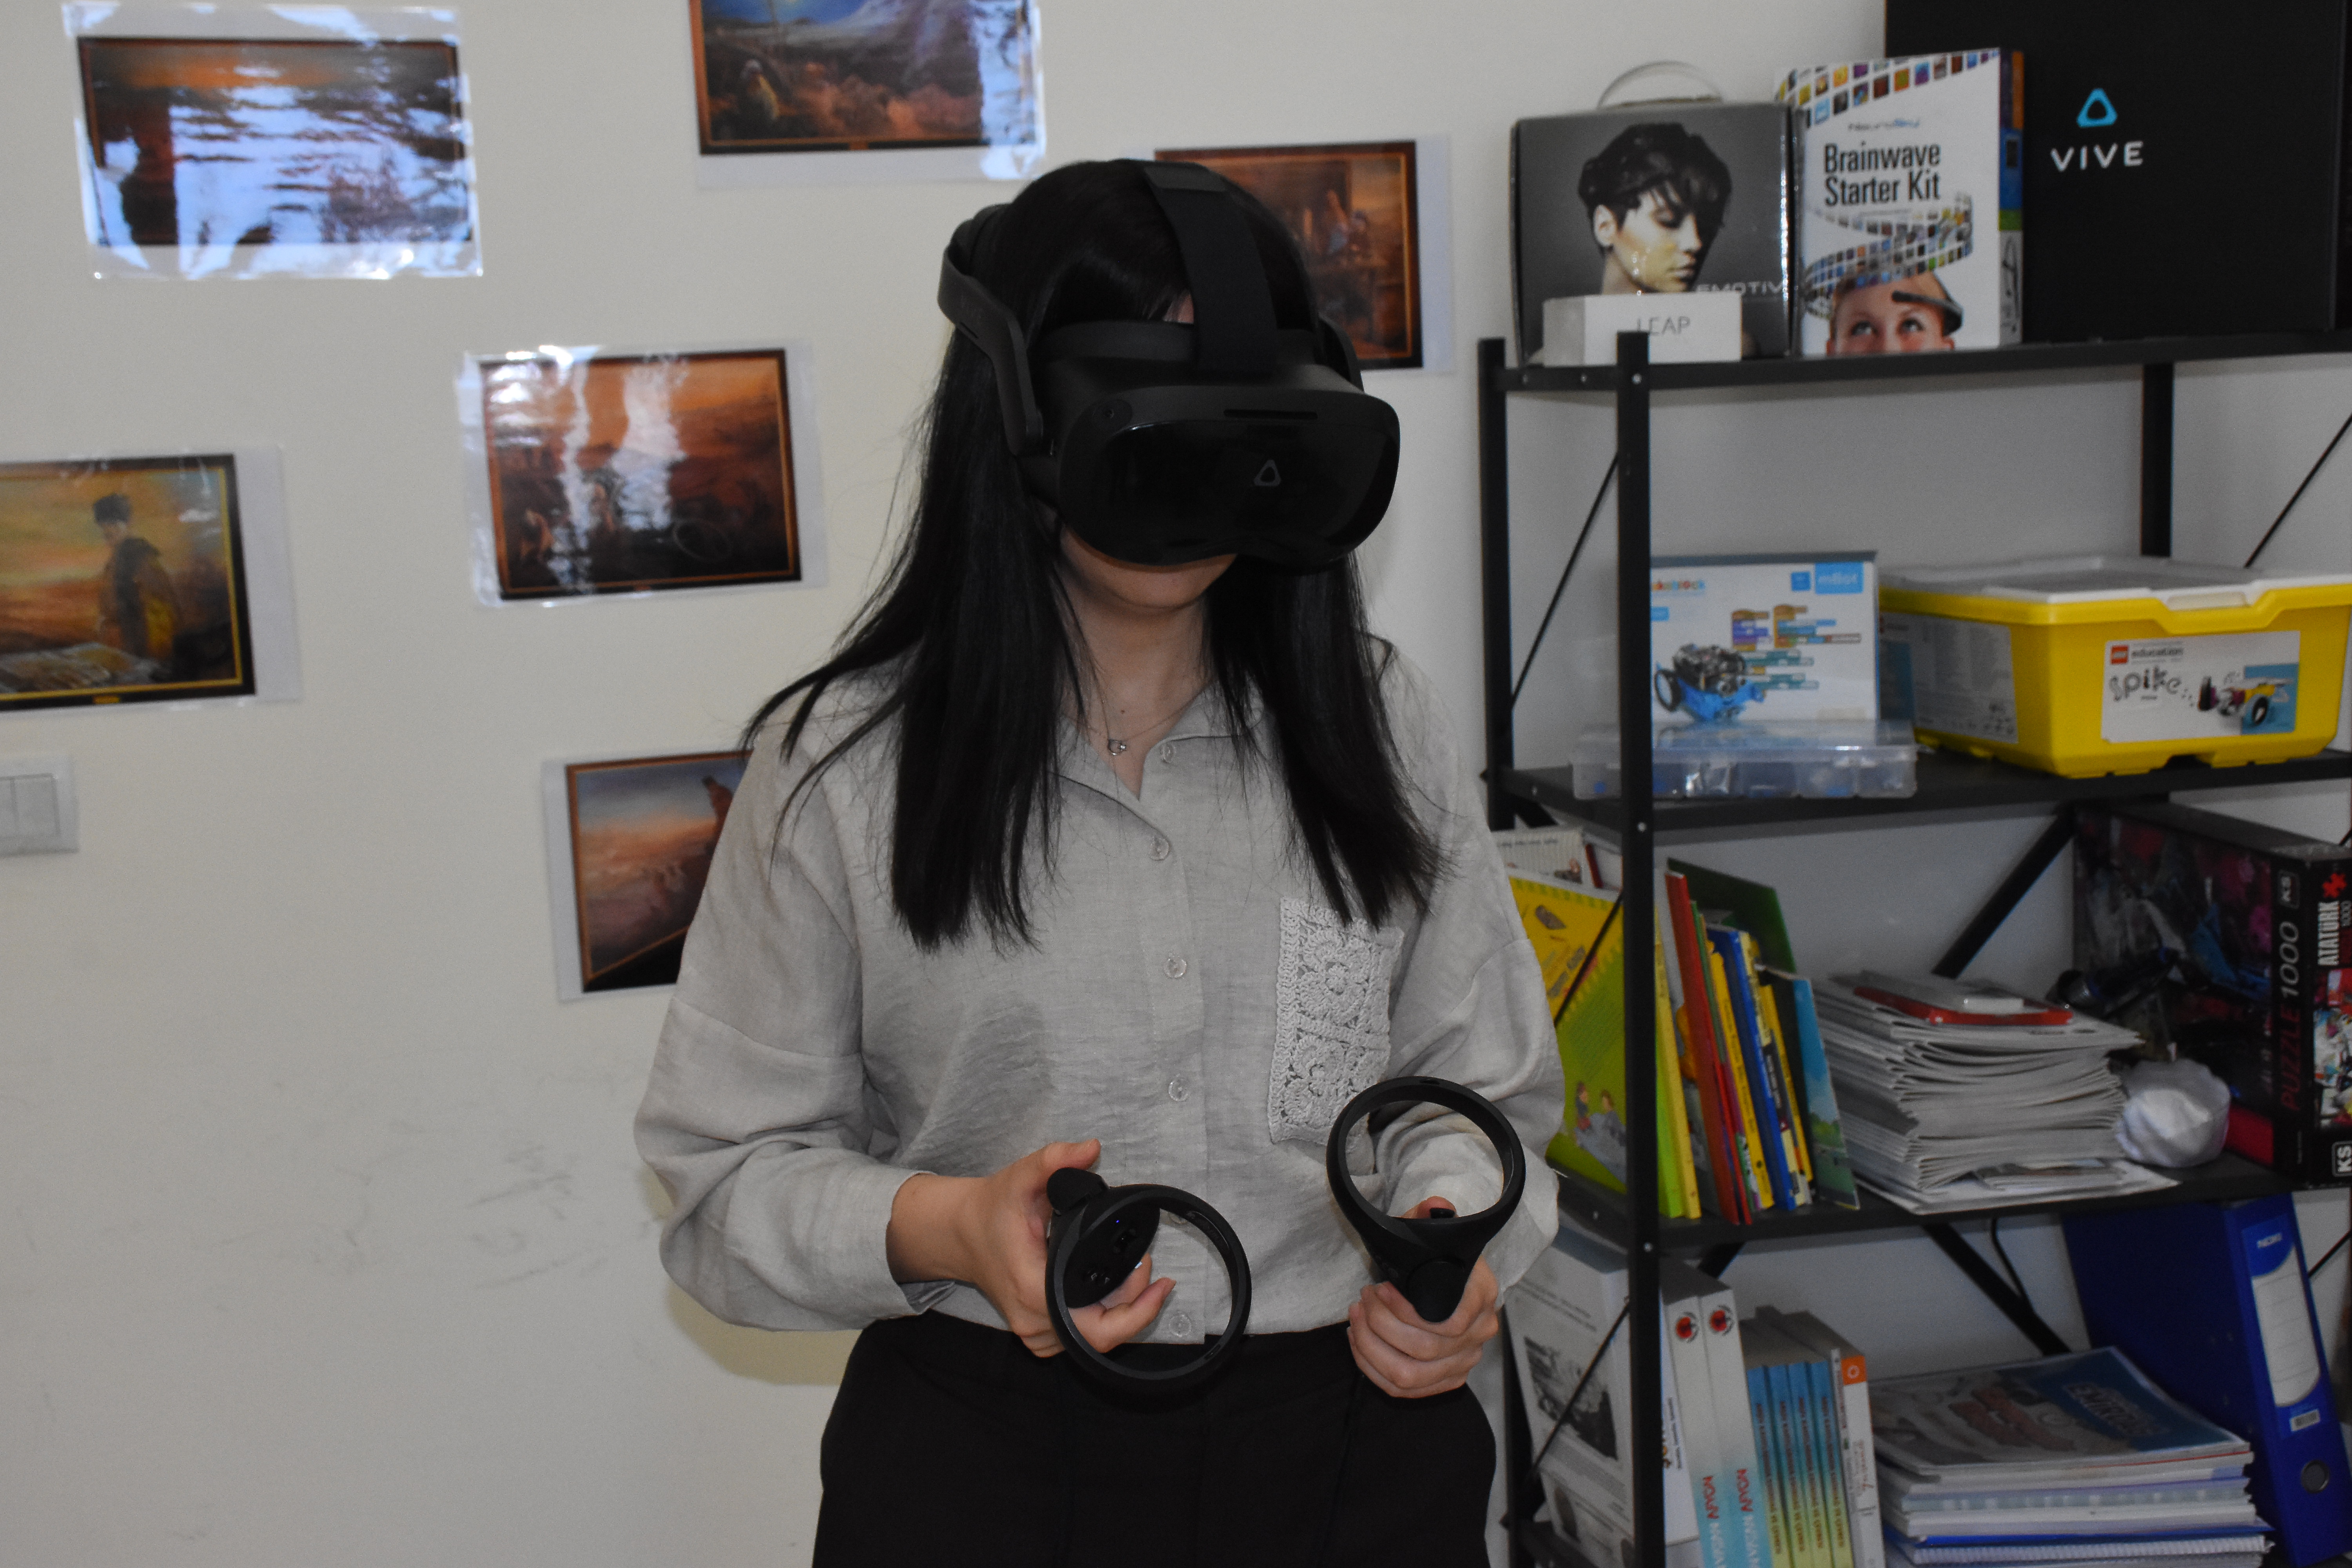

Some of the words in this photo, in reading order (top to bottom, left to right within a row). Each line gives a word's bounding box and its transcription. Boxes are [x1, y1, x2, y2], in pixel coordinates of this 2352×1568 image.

[1824, 142, 1941, 174] Brainwave
[2050, 141, 2144, 172] VIVE
[1824, 176, 1901, 207] Starter
[1908, 169, 1940, 201] Kit
[2279, 921, 2300, 999] 1000
[2280, 1004, 2301, 1111] PUZZLE
[2336, 1145, 2352, 1173] KS
